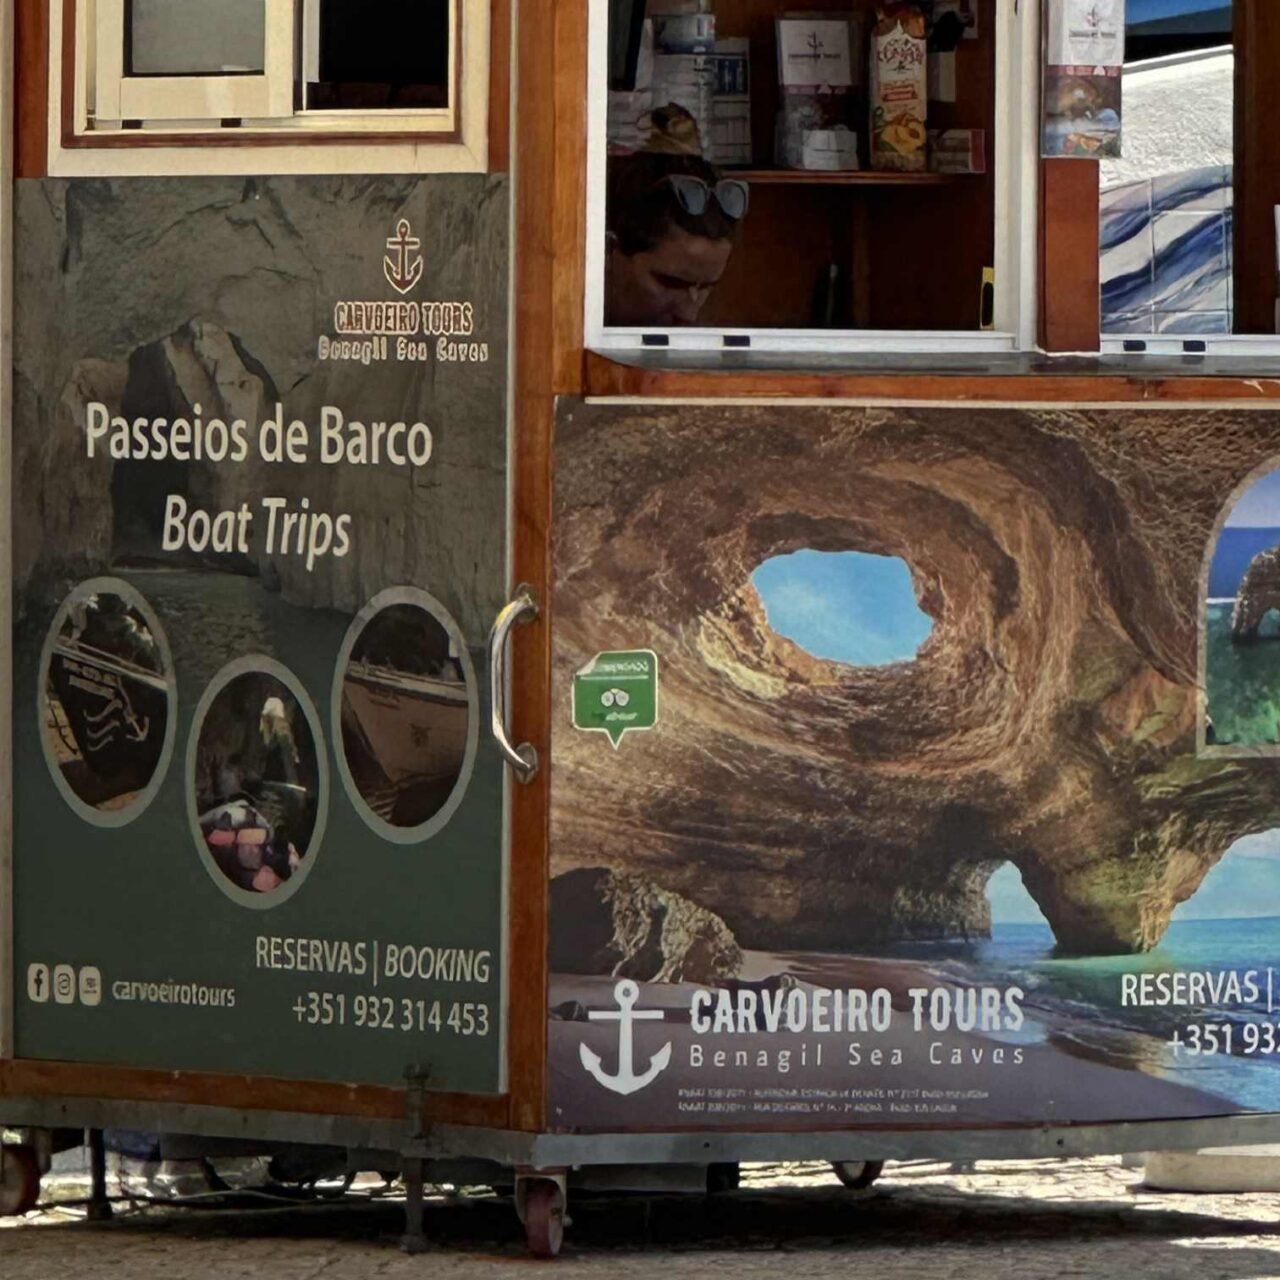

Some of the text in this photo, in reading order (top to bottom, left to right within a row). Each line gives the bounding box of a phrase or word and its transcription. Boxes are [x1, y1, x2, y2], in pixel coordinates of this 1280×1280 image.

[422, 302, 473, 335] TOURS
[87, 403, 432, 467] Passeios de Barco
[162, 496, 352, 572] Boat Trips
[256, 936, 367, 976] RESERVAS
[386, 943, 490, 983] BOOKING
[112, 979, 236, 1008] carvoeirotours
[1122, 972, 1258, 1007] RESERVAS
[293, 992, 489, 1036] +351 932 314 453
[690, 987, 1025, 1033] CARVOEIRO TOURS
[690, 1043, 1024, 1072] Benagil Sea Caves
[1168, 1023, 1232, 1056] +351
